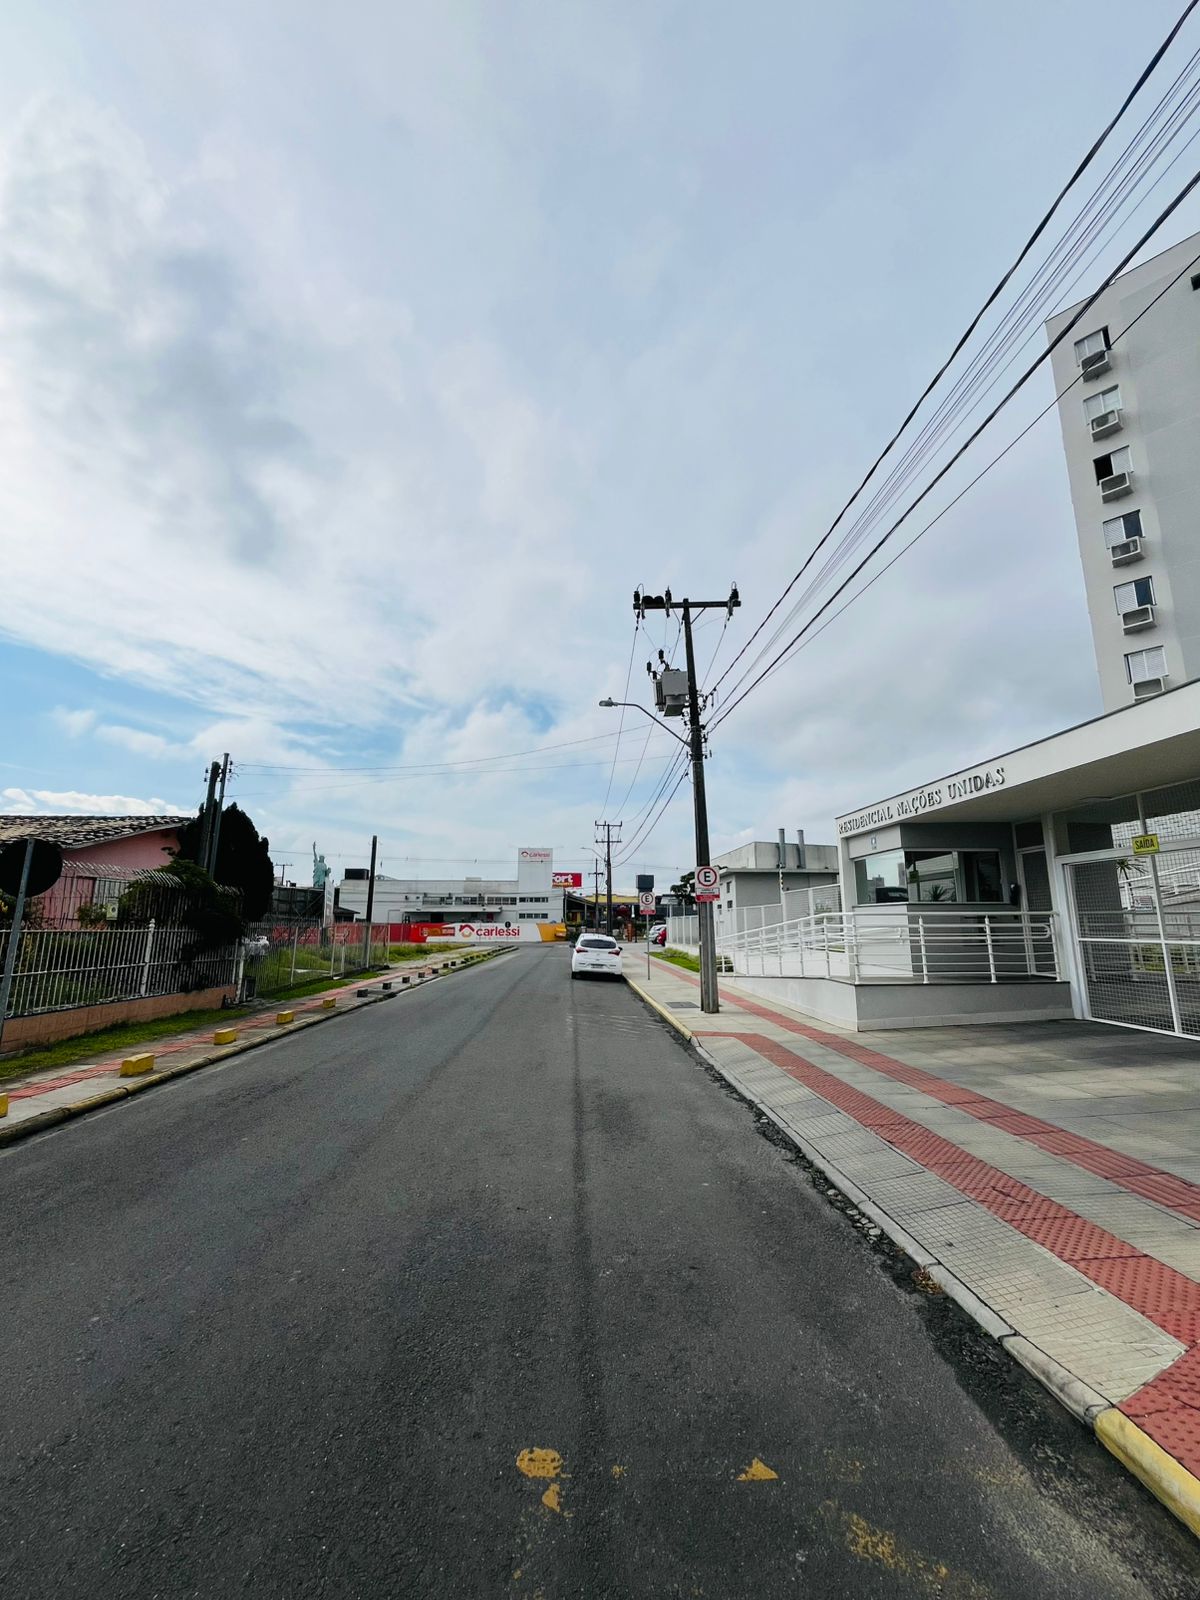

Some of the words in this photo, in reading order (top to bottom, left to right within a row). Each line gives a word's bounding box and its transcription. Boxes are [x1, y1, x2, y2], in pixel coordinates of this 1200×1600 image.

[839, 806, 893, 834] RESIDENCIAL
[897, 789, 942, 816] NAÇÕES
[948, 767, 1005, 799] UNIDAS
[1135, 838, 1155, 849] SAÍDA
[704, 871, 712, 882] E
[476, 926, 520, 937] carlessi
